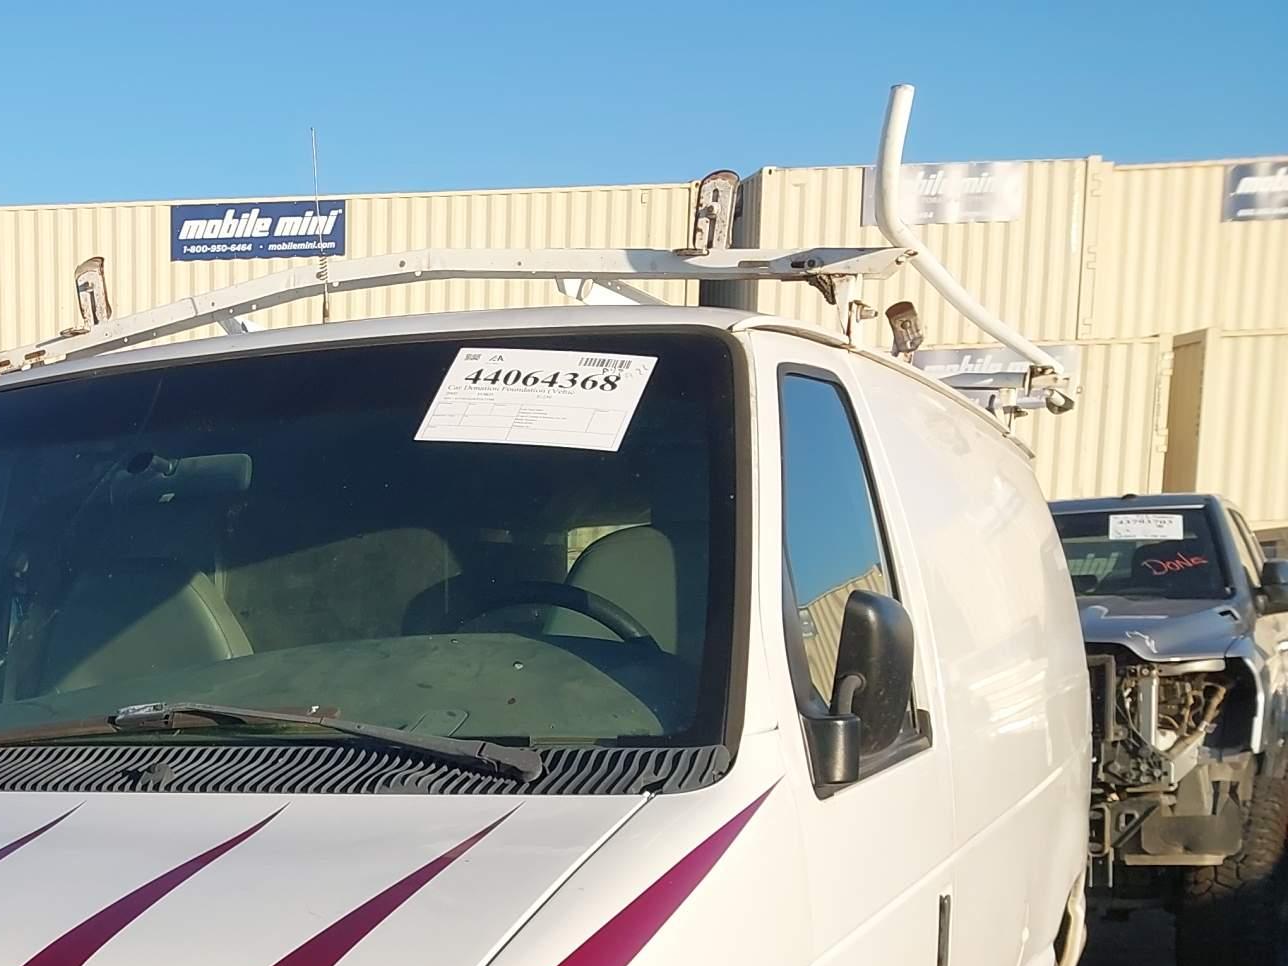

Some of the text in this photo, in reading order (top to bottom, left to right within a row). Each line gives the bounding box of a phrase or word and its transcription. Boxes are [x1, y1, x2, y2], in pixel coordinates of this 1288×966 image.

[178, 208, 339, 240] mobile mini
[268, 241, 336, 251] mobilemini.com
[464, 368, 622, 392] 44064368
